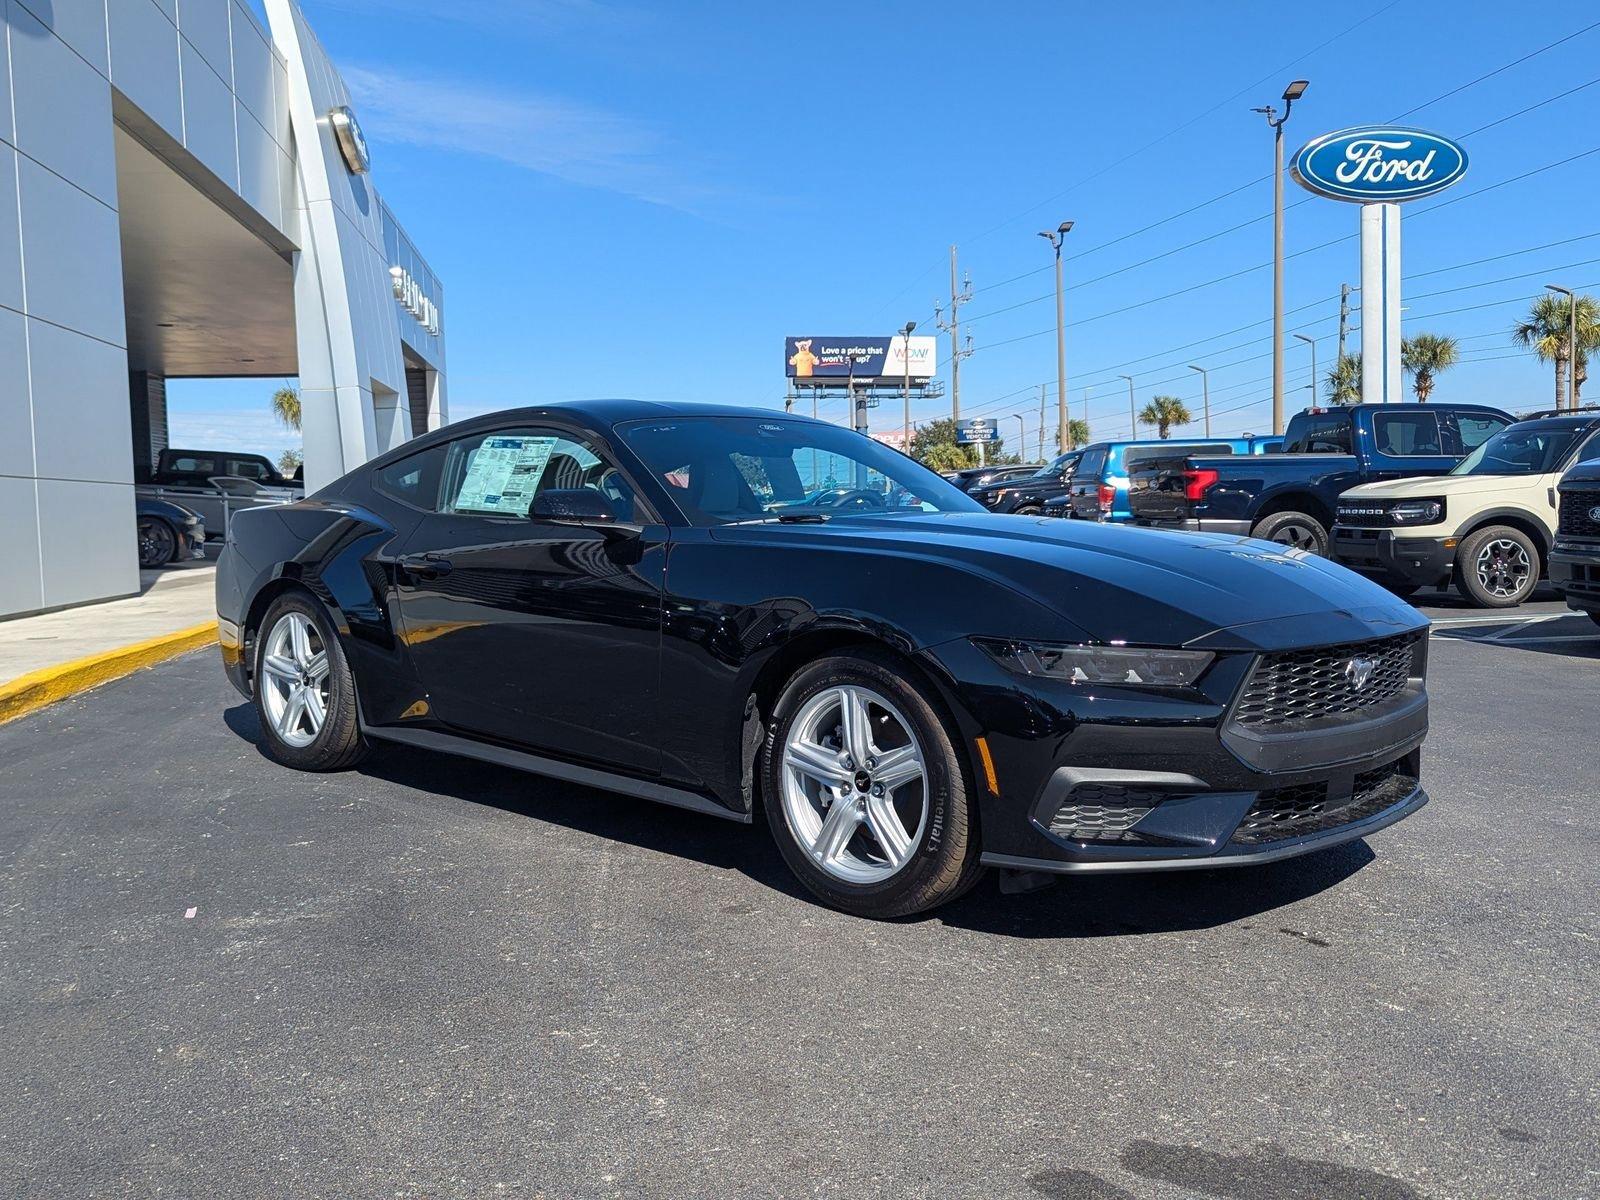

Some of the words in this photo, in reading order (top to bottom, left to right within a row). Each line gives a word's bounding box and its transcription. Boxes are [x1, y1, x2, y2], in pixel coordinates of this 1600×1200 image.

[1336, 139, 1436, 183] Ford
[821, 346, 839, 355] Love
[847, 346, 866, 356] price
[867, 346, 883, 355] that
[893, 347, 929, 358] WOW!
[821, 355, 844, 363] won't
[855, 355, 871, 365] up?
